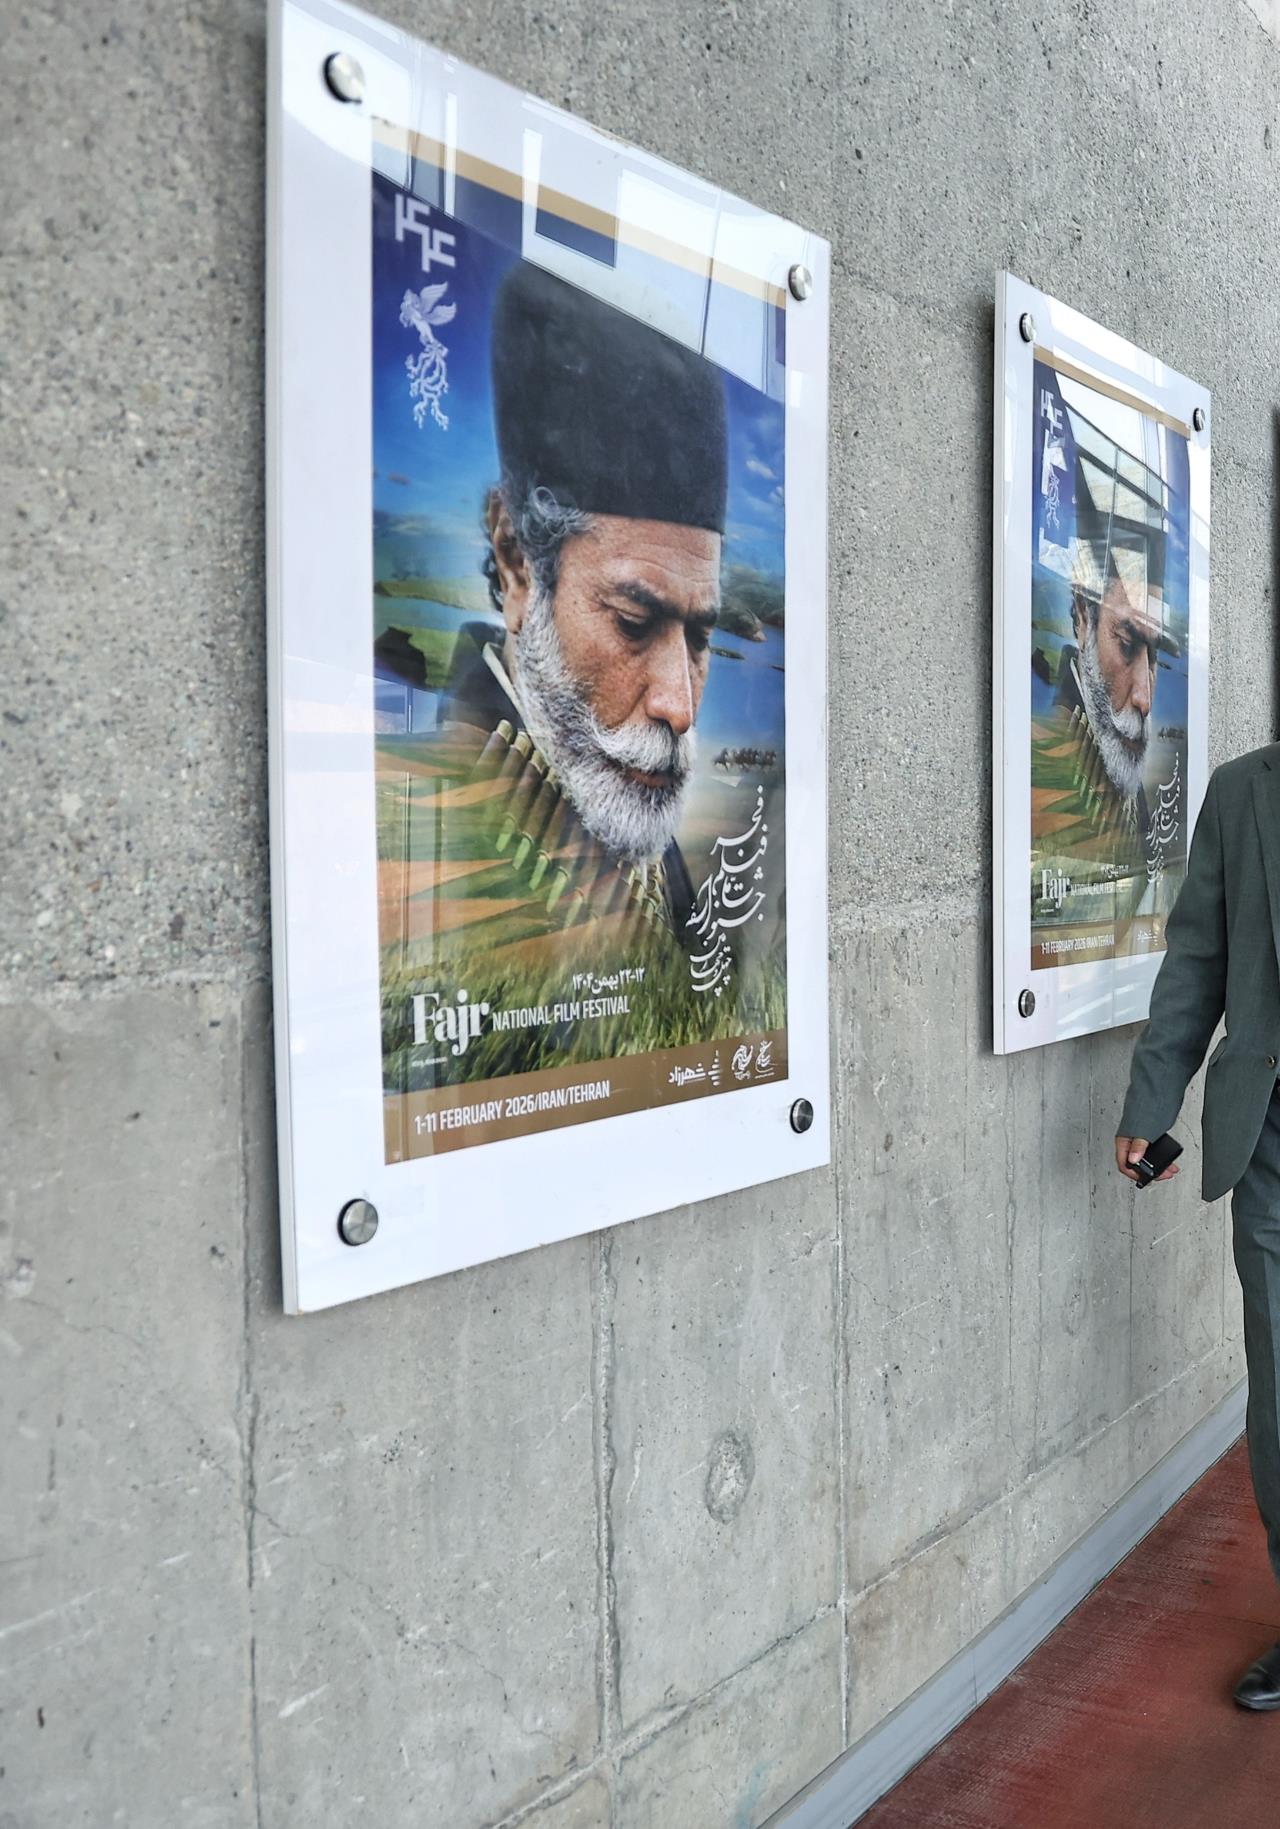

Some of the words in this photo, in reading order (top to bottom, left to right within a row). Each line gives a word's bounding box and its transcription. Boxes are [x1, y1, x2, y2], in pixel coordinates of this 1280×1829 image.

[411, 988, 490, 1056] Fajr
[492, 1005, 551, 1032] NATIONAL
[553, 1002, 580, 1023] FILM
[582, 995, 630, 1018] FESTIVAL
[414, 1112, 437, 1135] 1-11
[439, 1099, 503, 1131] FEBRUARY
[505, 1079, 610, 1118] 2026/IRAN/TEHRAN
